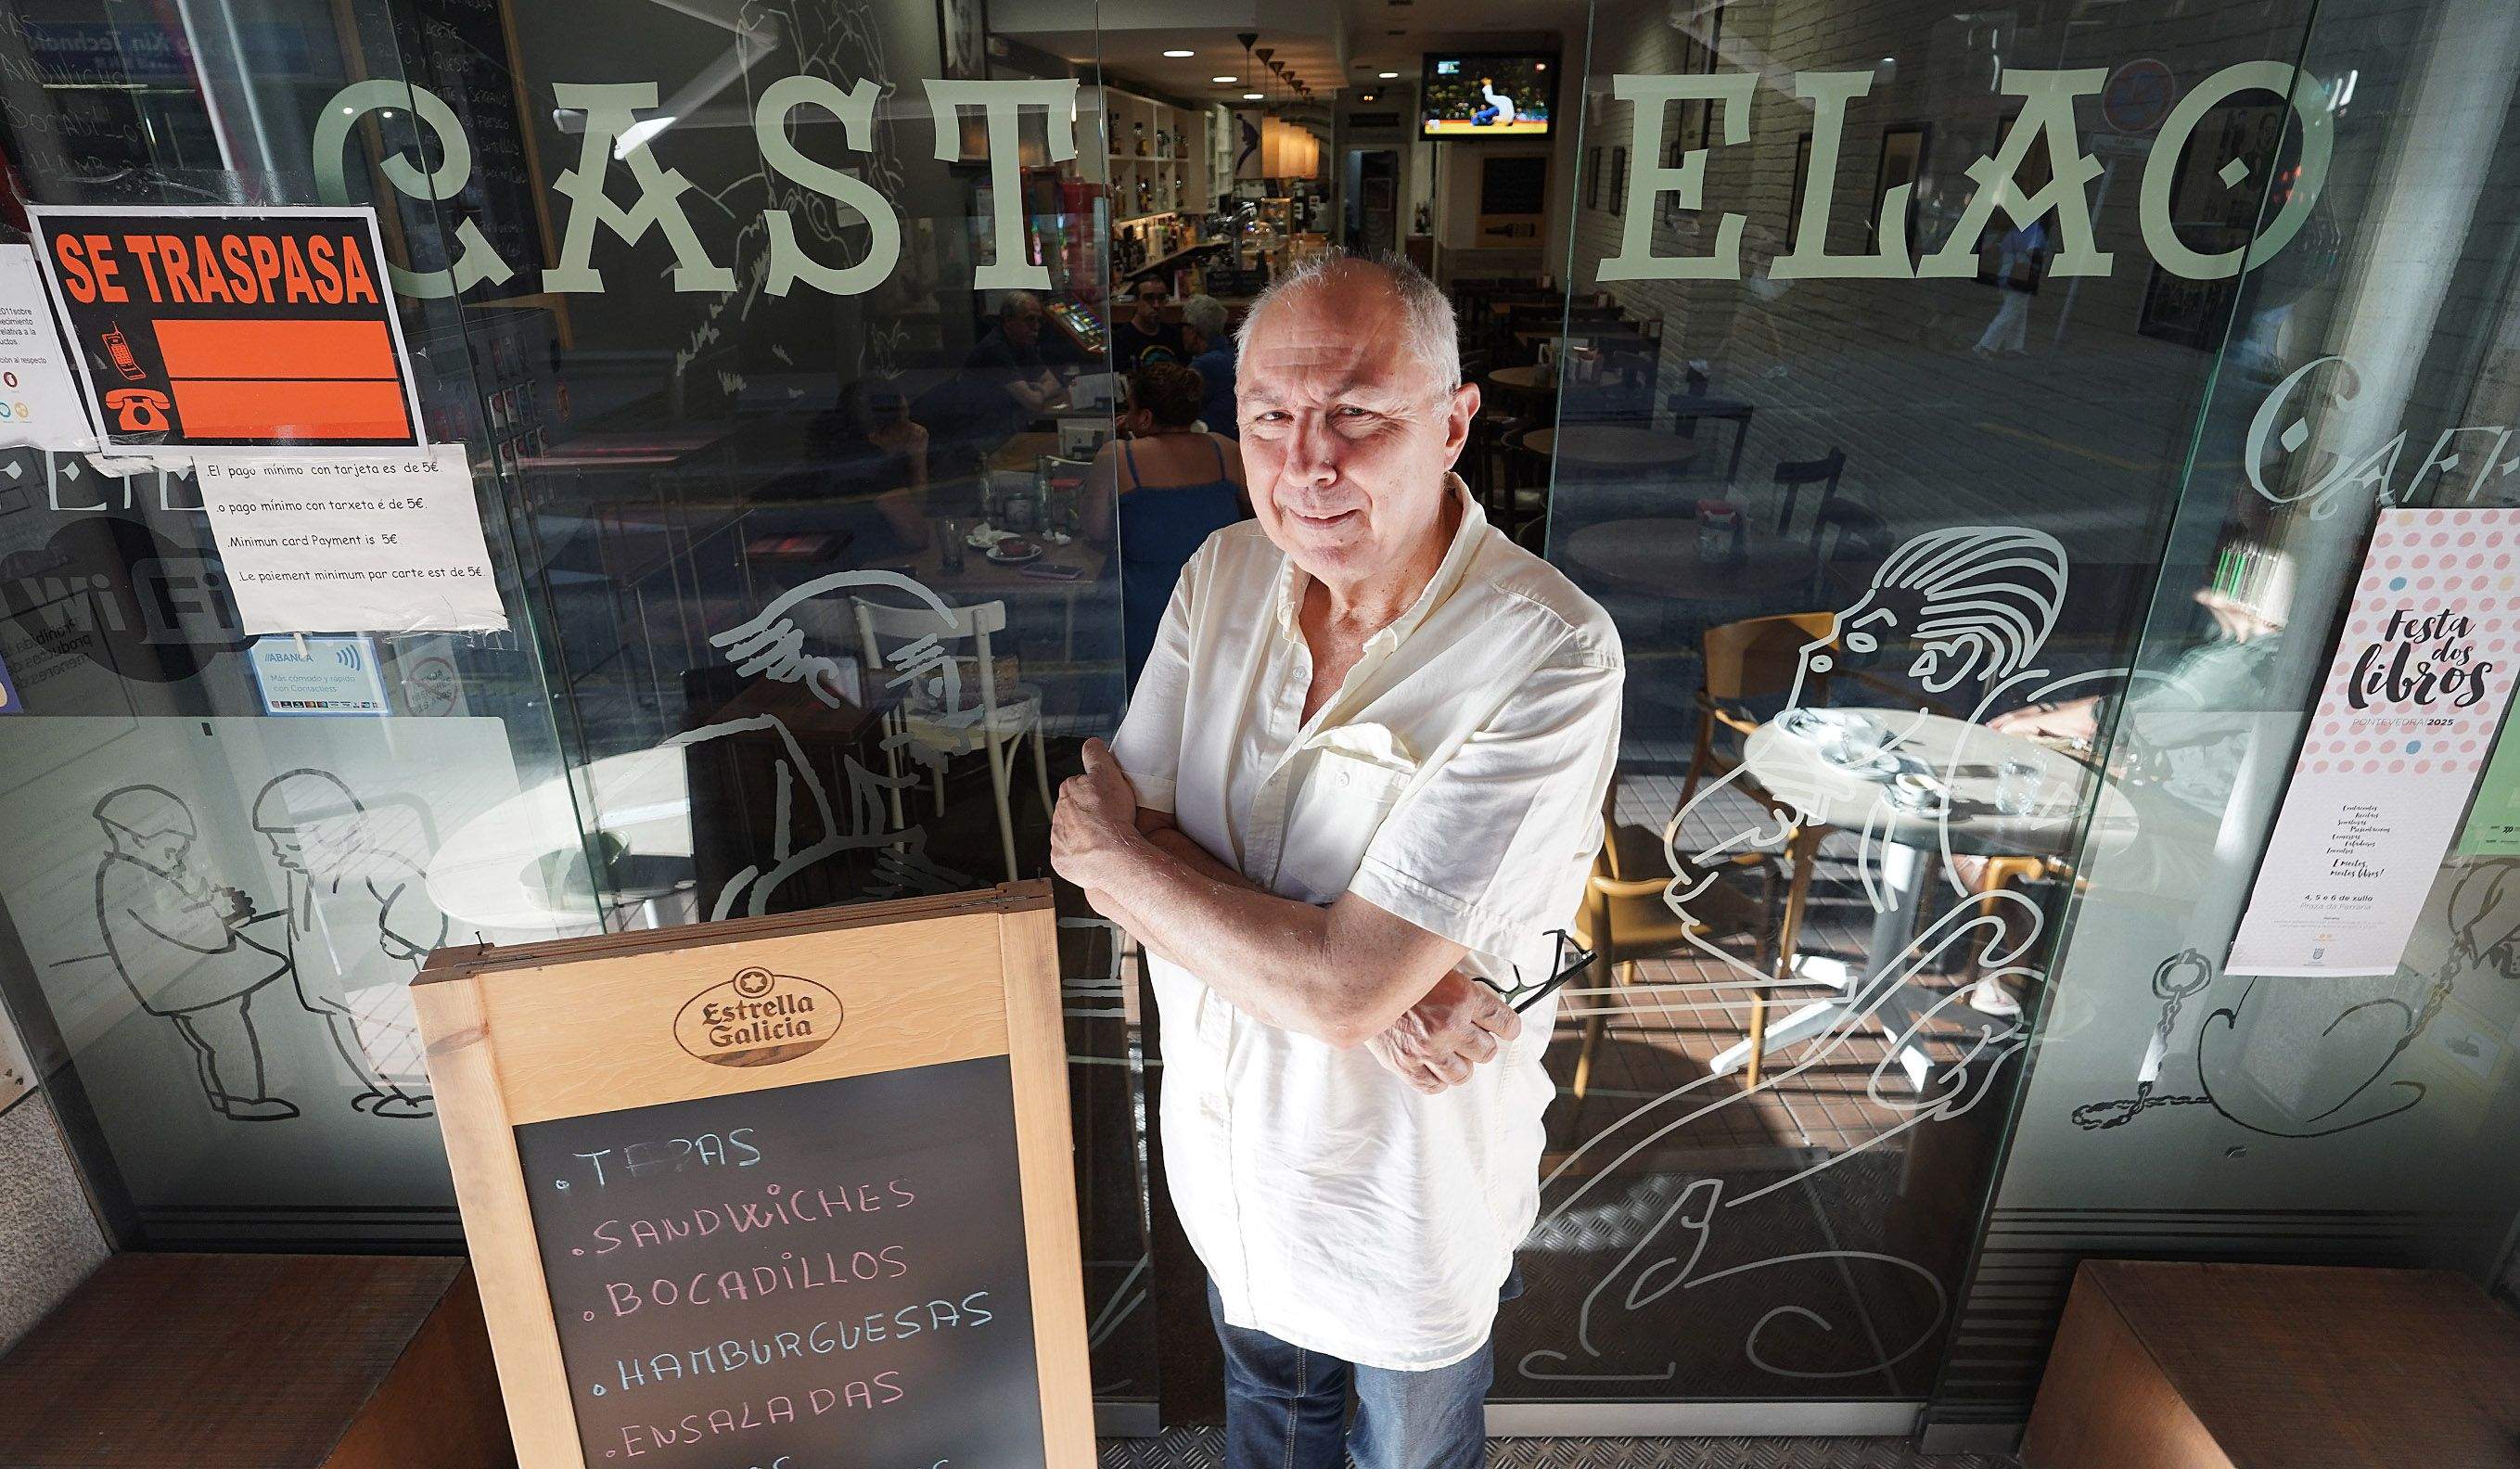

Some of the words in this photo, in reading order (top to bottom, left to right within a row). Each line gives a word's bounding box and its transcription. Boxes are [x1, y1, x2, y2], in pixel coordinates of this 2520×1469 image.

[56, 234, 129, 303] SE
[123, 235, 378, 304] TRASPASA
[228, 466, 257, 479] pago
[263, 463, 303, 476] mínimo
[311, 466, 331, 475] con
[334, 464, 379, 478] tarjeta
[383, 466, 396, 474] es
[403, 463, 419, 474] de
[228, 503, 257, 515] pago
[261, 498, 302, 511] mínimo
[306, 501, 326, 511] con
[328, 499, 375, 511] tarxeta
[377, 499, 385, 509] é
[389, 499, 403, 510] de
[281, 535, 309, 546] card
[312, 534, 361, 548] Payment
[365, 534, 375, 545] is
[259, 571, 311, 582] paiement
[314, 570, 365, 581] minimum
[368, 570, 388, 581] par
[391, 568, 425, 579] carte
[428, 568, 446, 578] est
[450, 567, 465, 577] de
[2385, 608, 2476, 644] Festa
[2432, 636, 2474, 666] dos
[324, 678, 329, 686] y
[2347, 642, 2493, 709] libros
[702, 994, 815, 1026] Estrella
[709, 1016, 813, 1048] Galicia
[616, 1291, 993, 1390] HAMBURGUESAS
